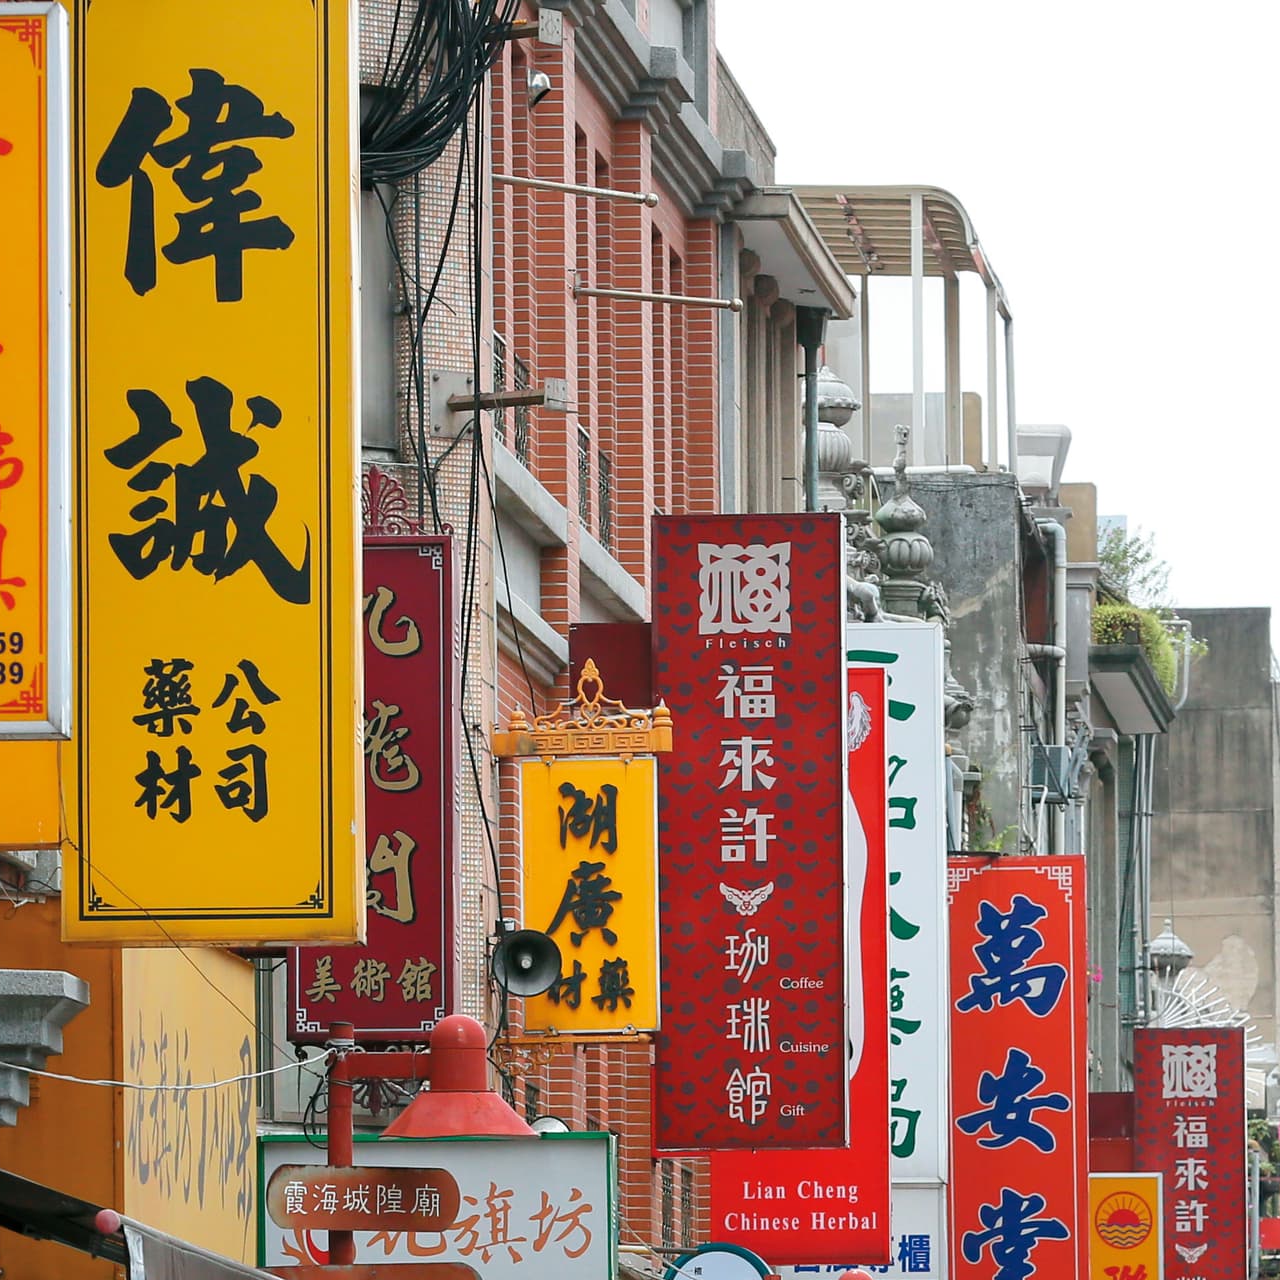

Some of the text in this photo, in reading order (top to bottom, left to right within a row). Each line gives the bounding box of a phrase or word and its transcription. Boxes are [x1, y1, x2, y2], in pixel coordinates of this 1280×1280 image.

[95, 67, 312, 604] 偉誠
[705, 637, 788, 650] Fleisch
[715, 664, 777, 862] 福來許
[305, 956, 437, 1004] 美術館
[779, 977, 824, 990] Coffee
[779, 1041, 829, 1054] Cuisine
[780, 1103, 806, 1118] Gift
[1173, 1115, 1209, 1233] 福來許
[283, 1181, 442, 1218] 霞海城隍廟
[743, 1180, 858, 1203] Lian Cheng
[724, 1211, 879, 1231] Chinese Herbal
